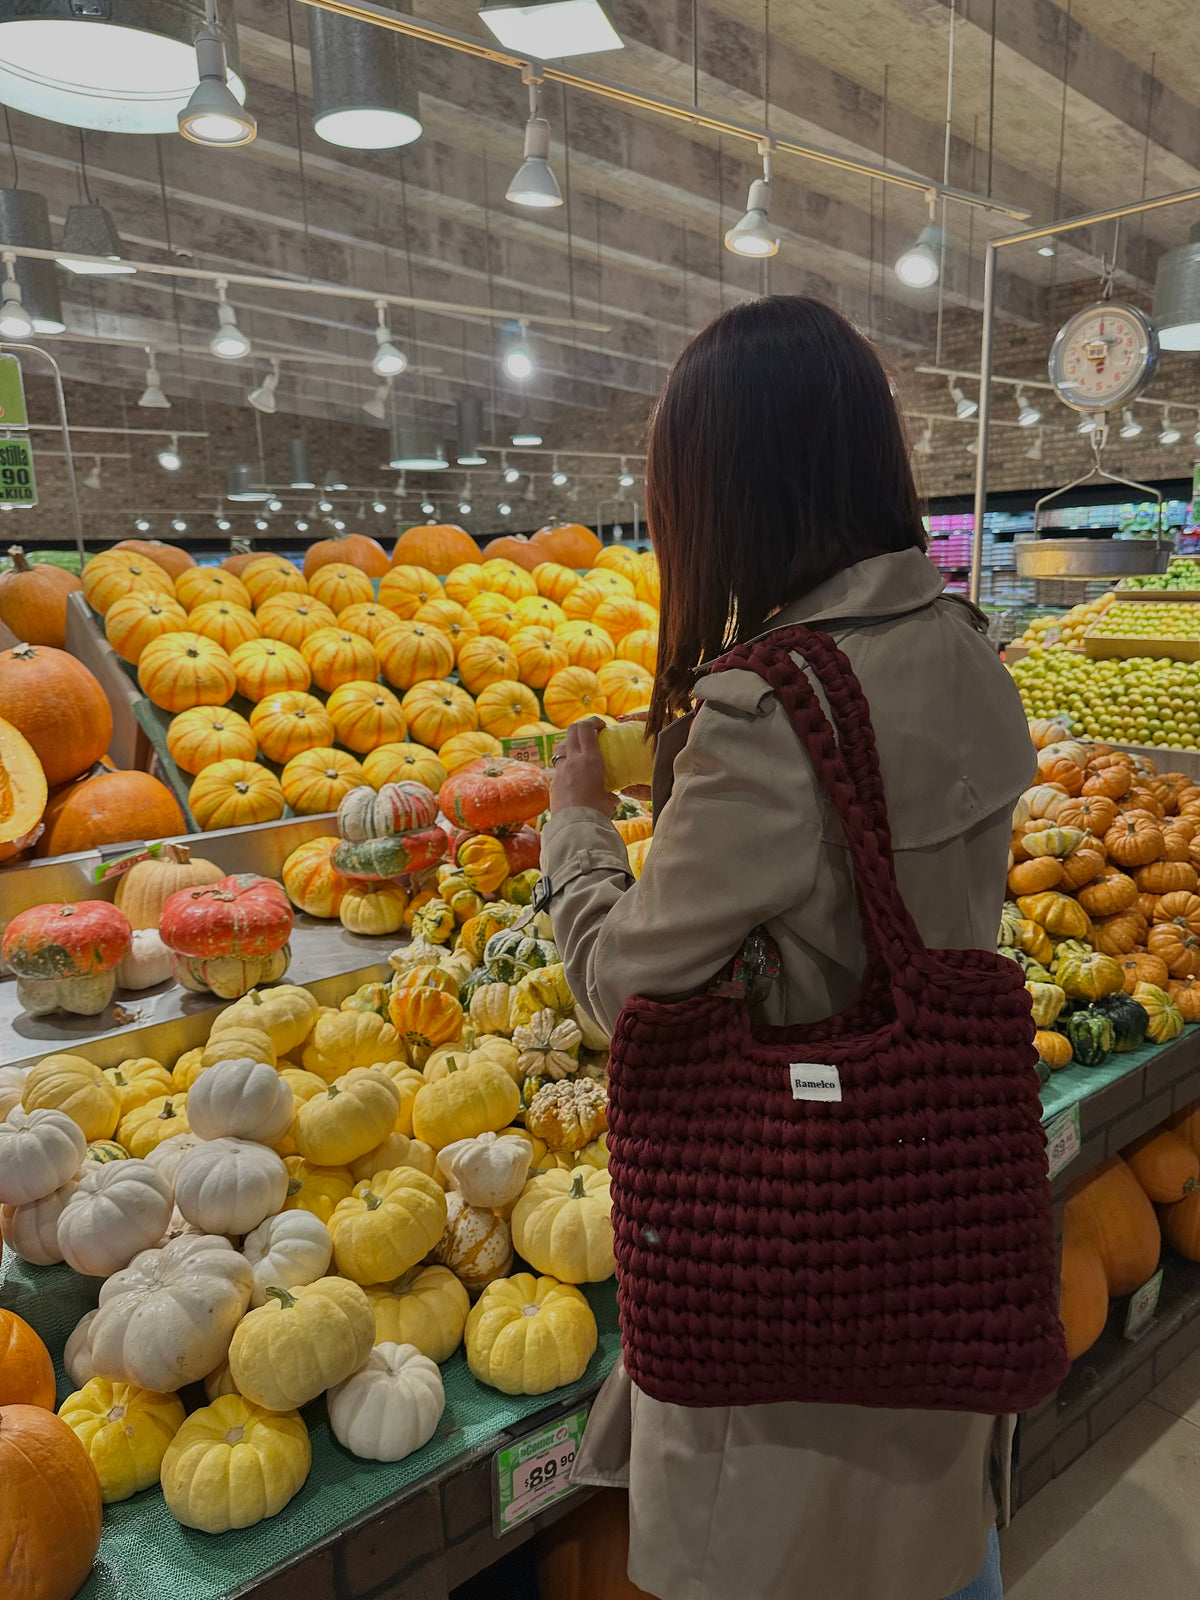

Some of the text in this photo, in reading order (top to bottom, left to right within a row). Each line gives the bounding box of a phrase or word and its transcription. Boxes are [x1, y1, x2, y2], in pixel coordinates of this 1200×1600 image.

[2, 468, 30, 486] 90
[794, 1079, 836, 1089] Ramelco
[560, 1452, 575, 1467] 90
